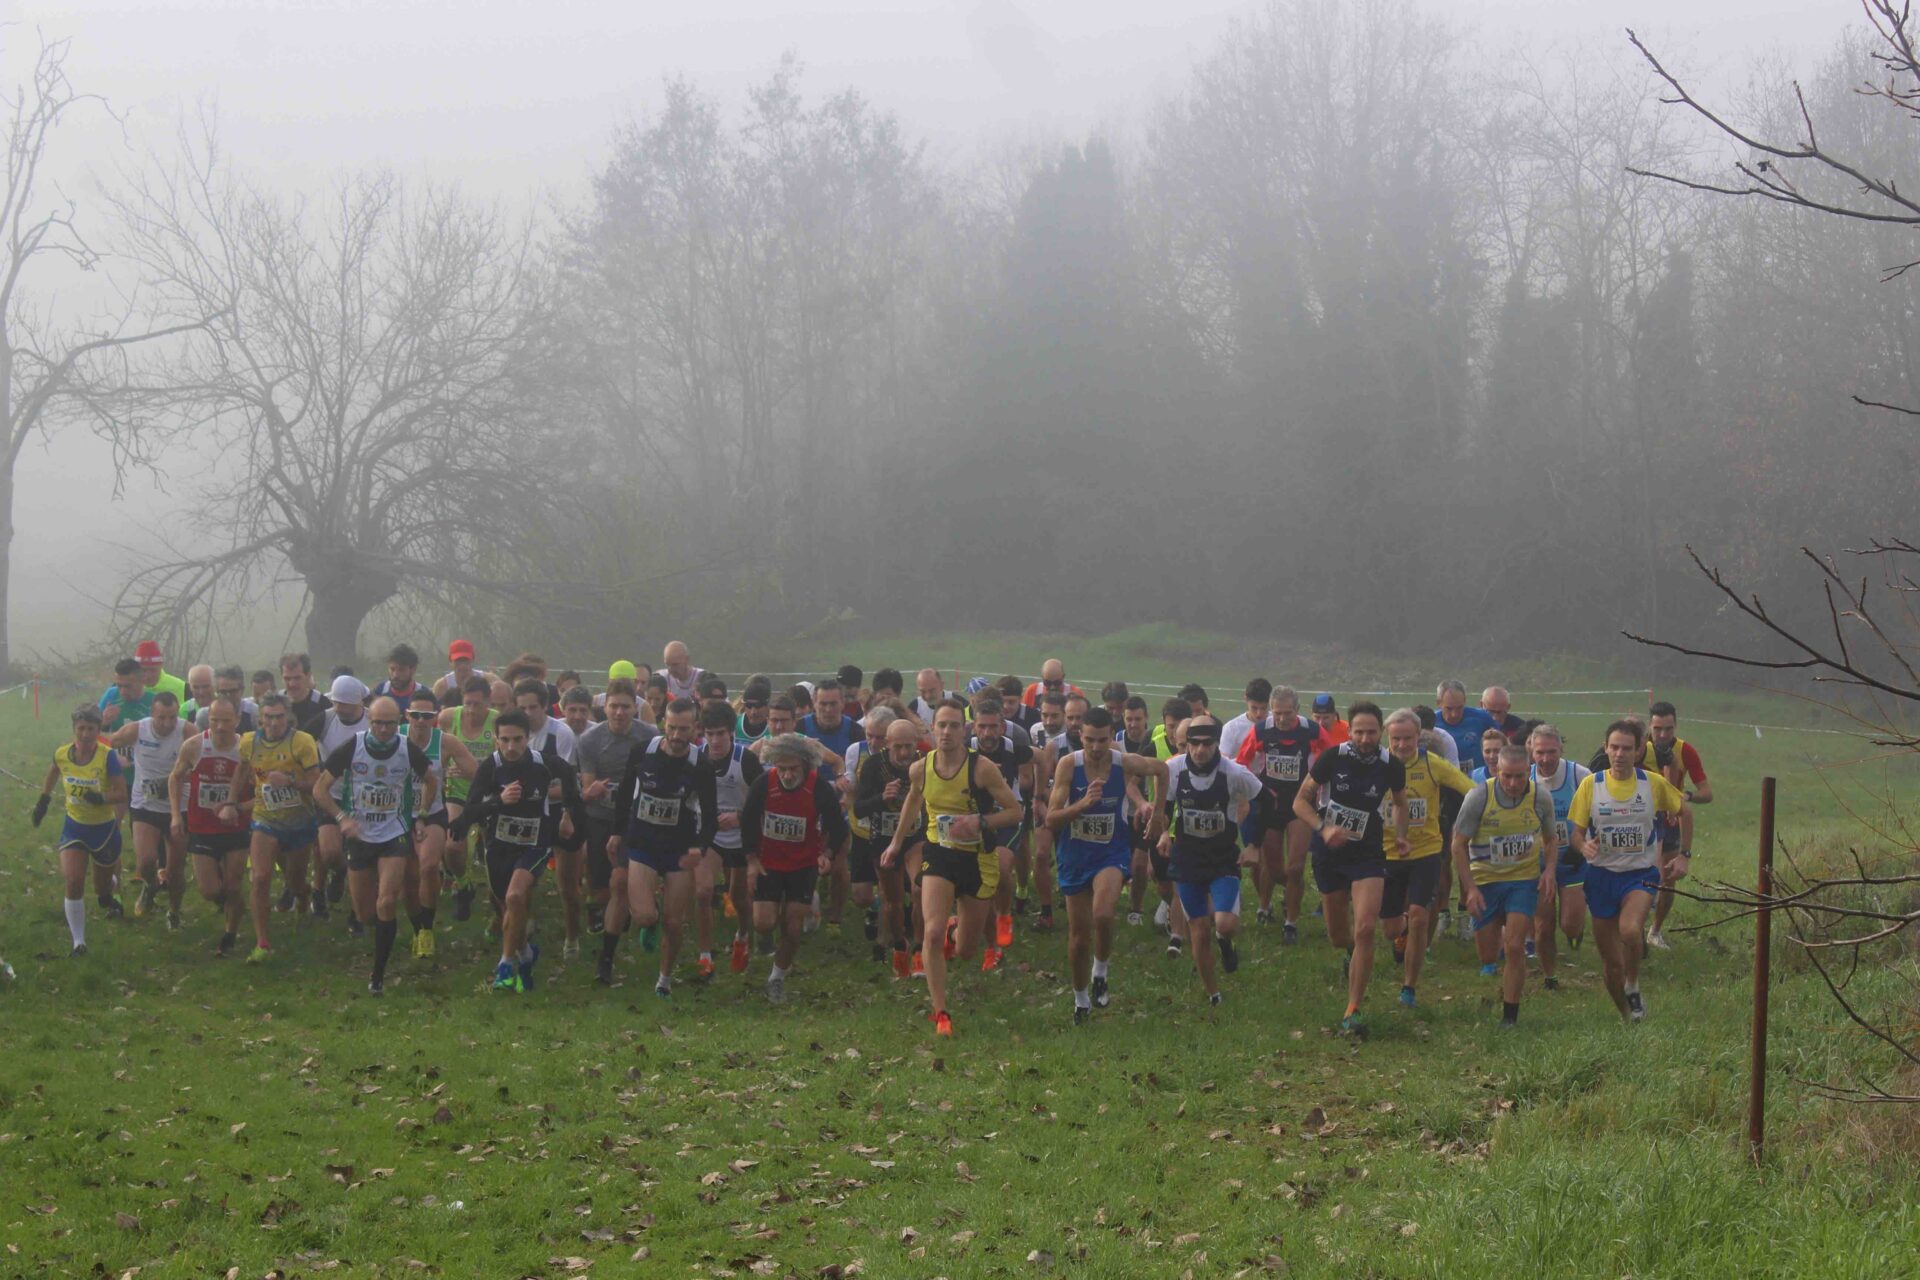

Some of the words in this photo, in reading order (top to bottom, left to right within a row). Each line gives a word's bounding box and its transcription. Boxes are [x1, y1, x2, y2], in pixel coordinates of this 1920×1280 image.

[1088, 822, 1103, 836] 35
[1341, 815, 1354, 831] 75
[1614, 833, 1635, 847] 136
